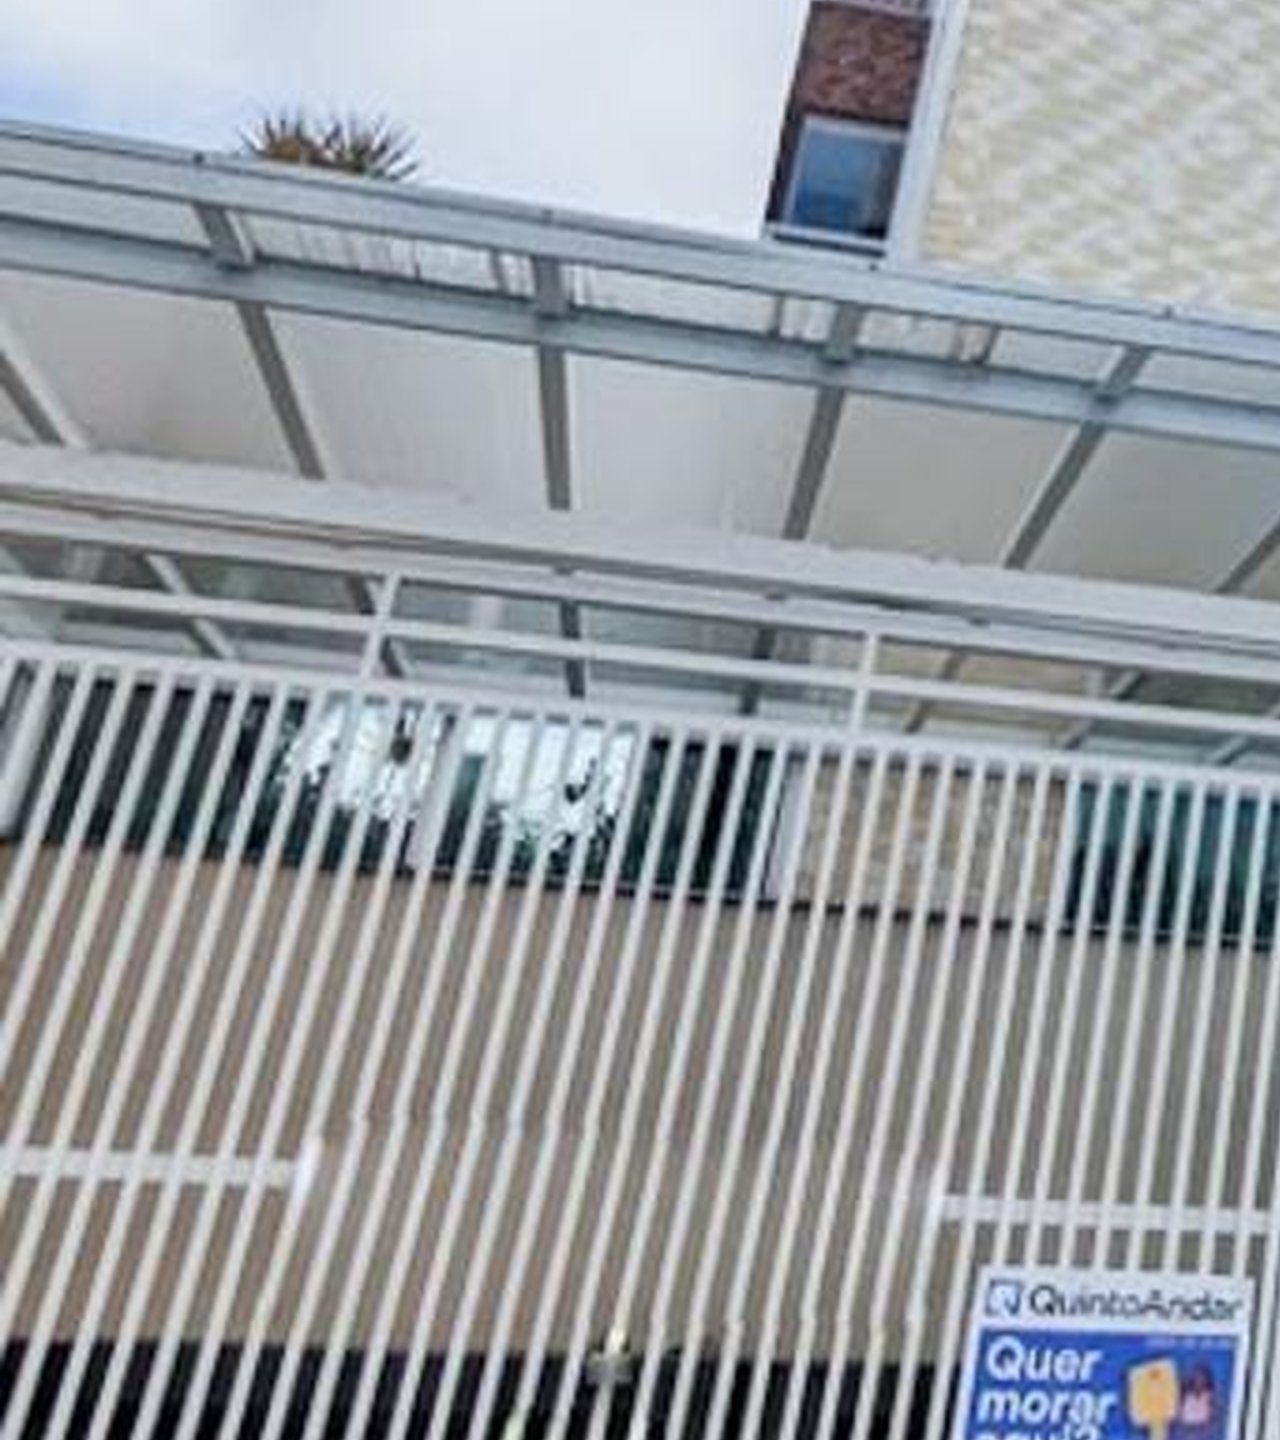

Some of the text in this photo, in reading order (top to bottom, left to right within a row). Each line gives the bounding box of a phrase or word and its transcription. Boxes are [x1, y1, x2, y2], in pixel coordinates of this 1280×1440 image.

[1030, 1283, 1242, 1321] QuintoAndar
[987, 1335, 1102, 1382] Quer
[977, 1389, 1117, 1425] morar
